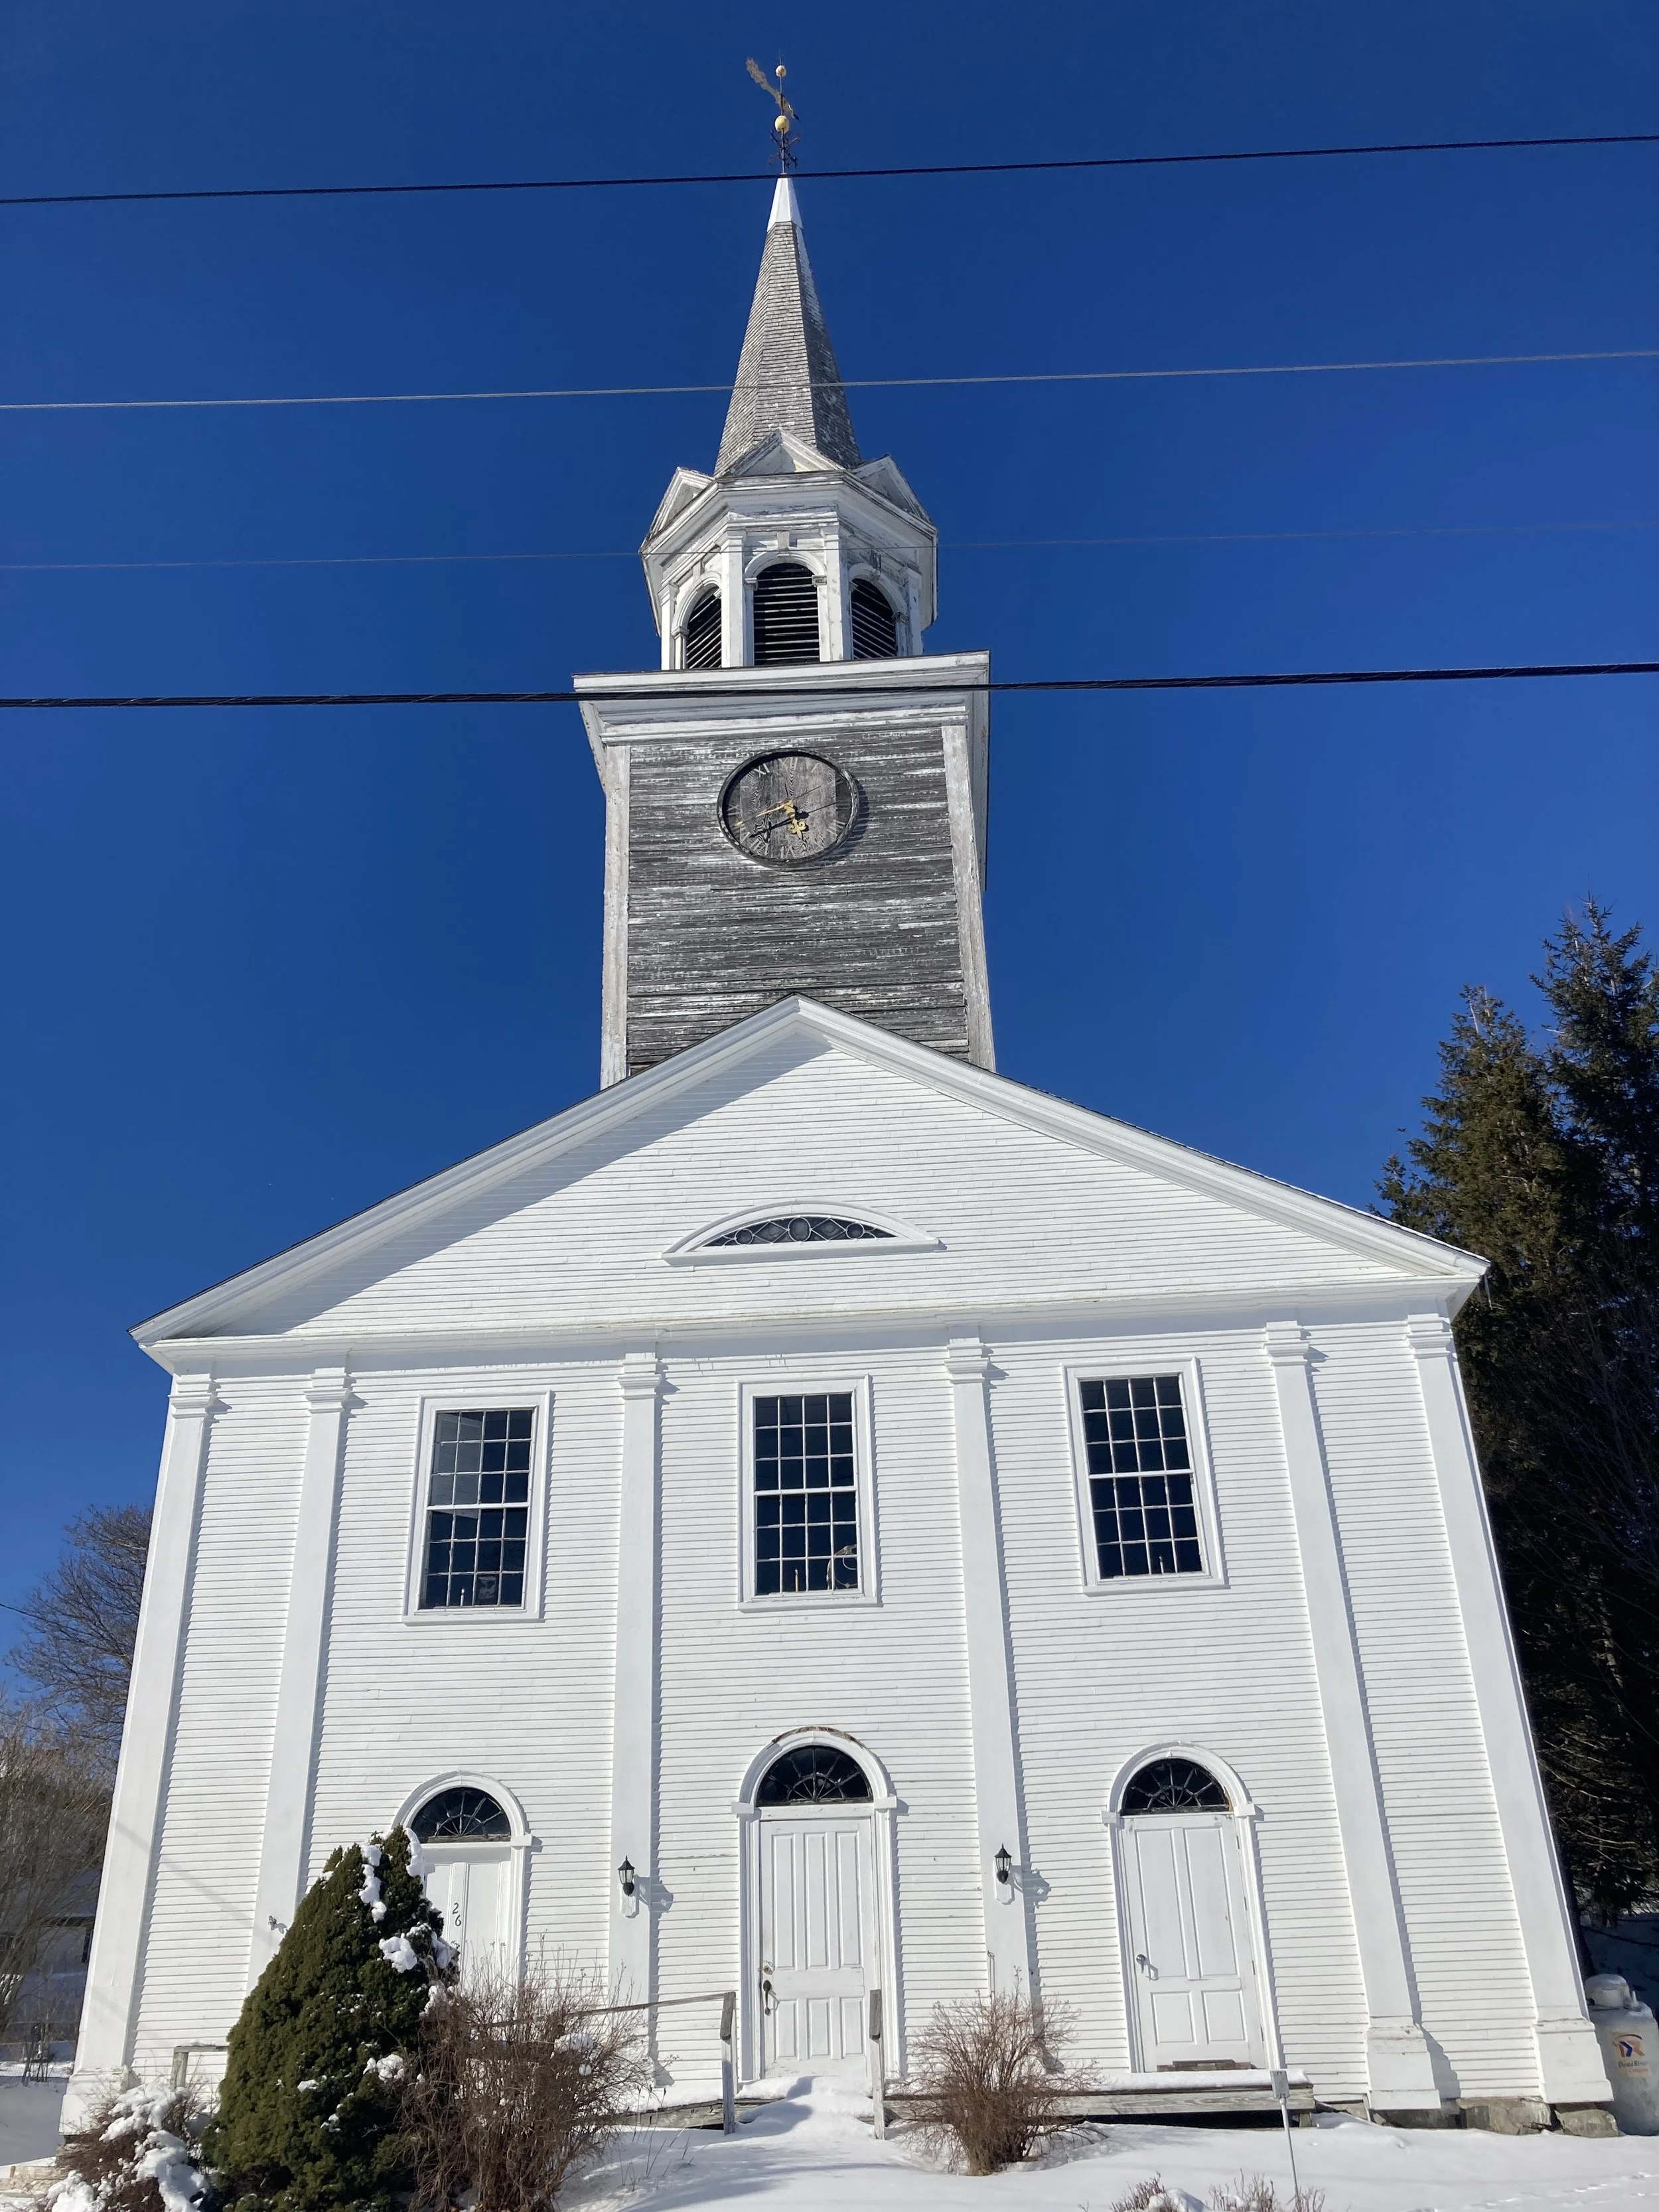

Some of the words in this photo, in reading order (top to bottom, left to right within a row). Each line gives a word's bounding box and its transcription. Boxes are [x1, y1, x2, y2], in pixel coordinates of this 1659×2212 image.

[753, 763, 770, 778] XI
[777, 757, 798, 773] XII
[727, 804, 741, 816] IX
